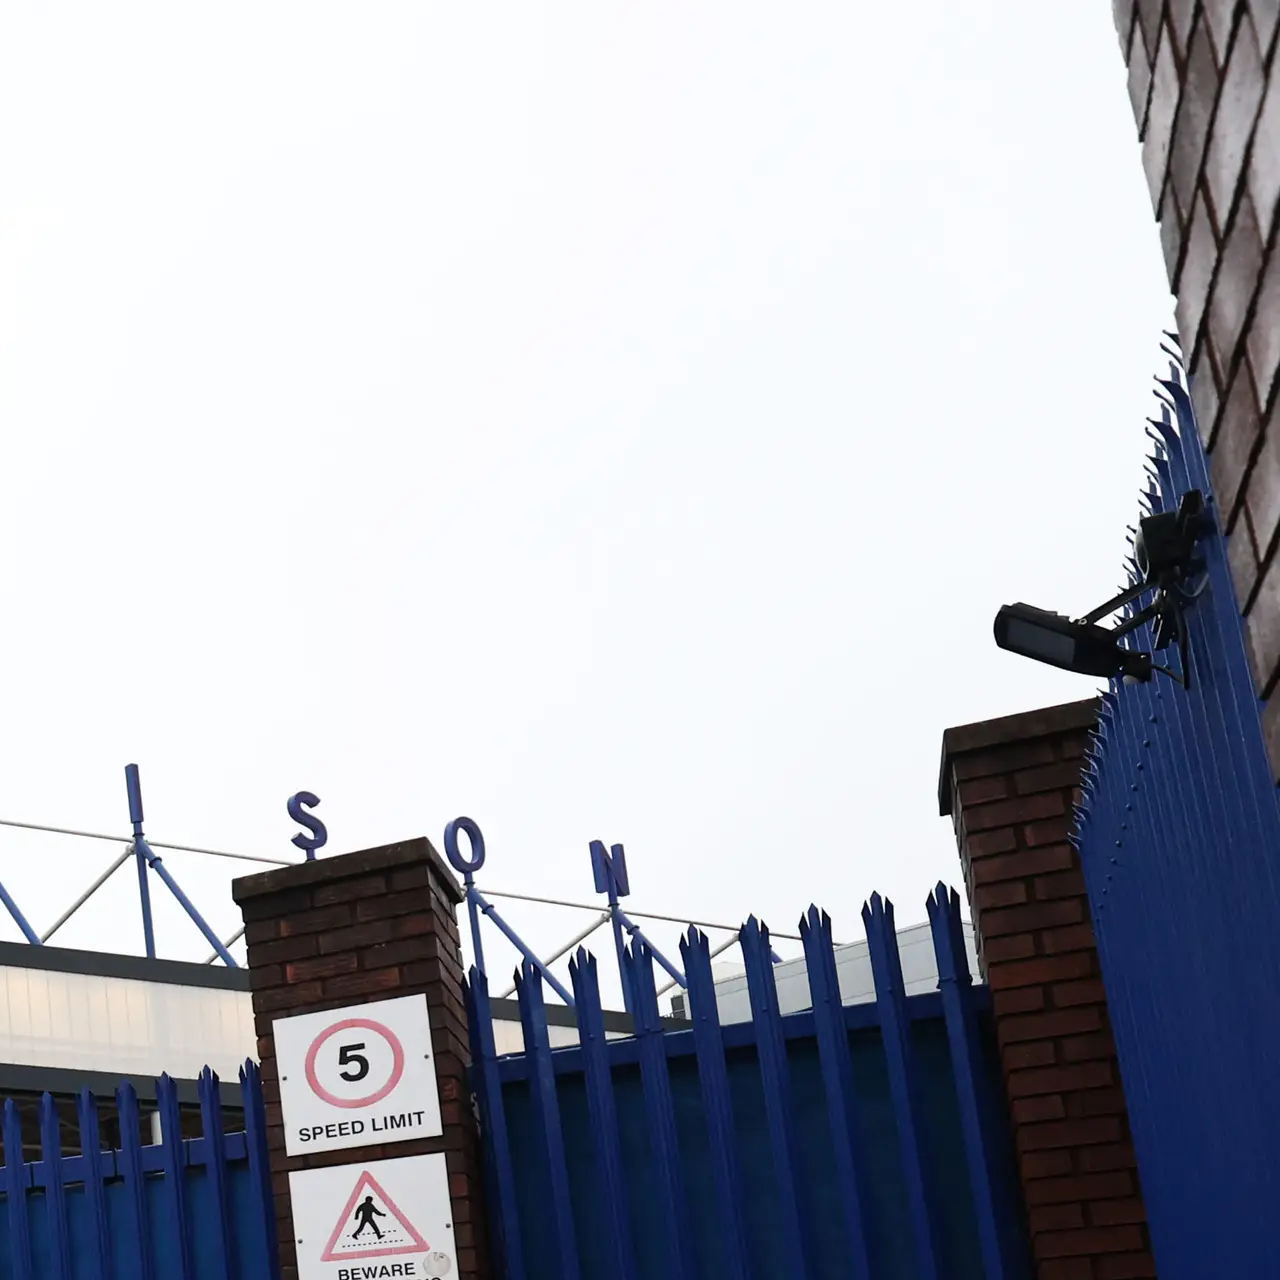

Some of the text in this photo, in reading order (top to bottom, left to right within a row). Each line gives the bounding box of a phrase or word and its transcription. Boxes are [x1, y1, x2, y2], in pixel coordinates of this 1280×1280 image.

[338, 1042, 370, 1082] 5
[298, 1110, 425, 1142] SPEED LIMIT
[338, 1262, 416, 1280] BEWARE
